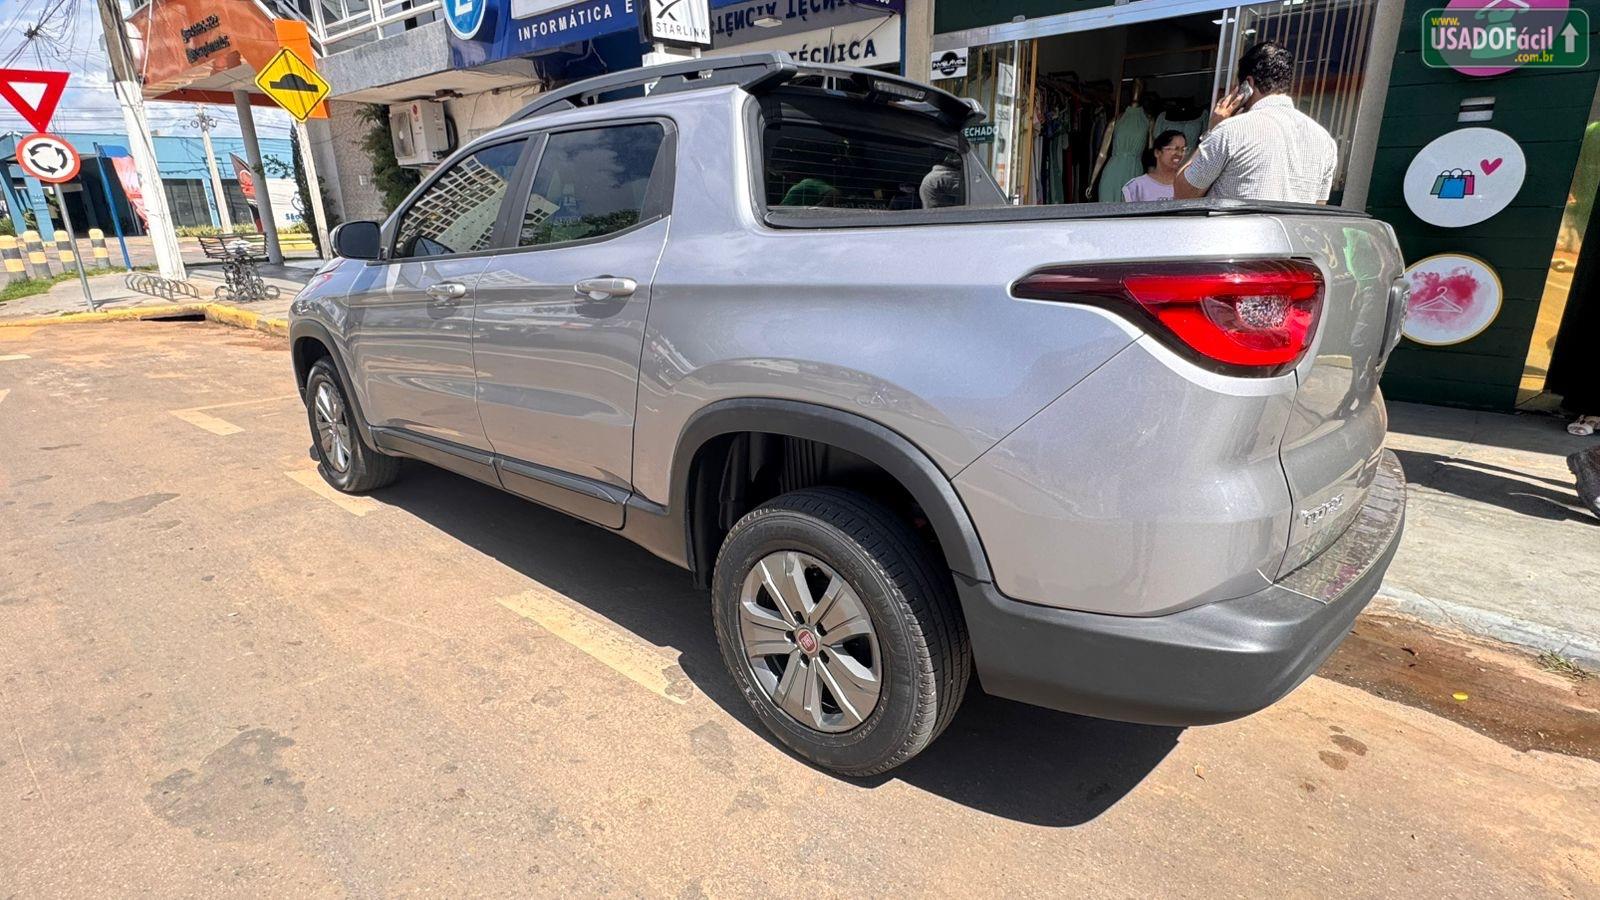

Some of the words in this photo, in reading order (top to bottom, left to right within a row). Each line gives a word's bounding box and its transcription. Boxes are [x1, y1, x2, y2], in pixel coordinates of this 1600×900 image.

[518, 4, 612, 41] INFORMÁTICA
[625, 0, 634, 14] E
[656, 21, 707, 38] STARLINK
[963, 125, 999, 137] ECHADO
